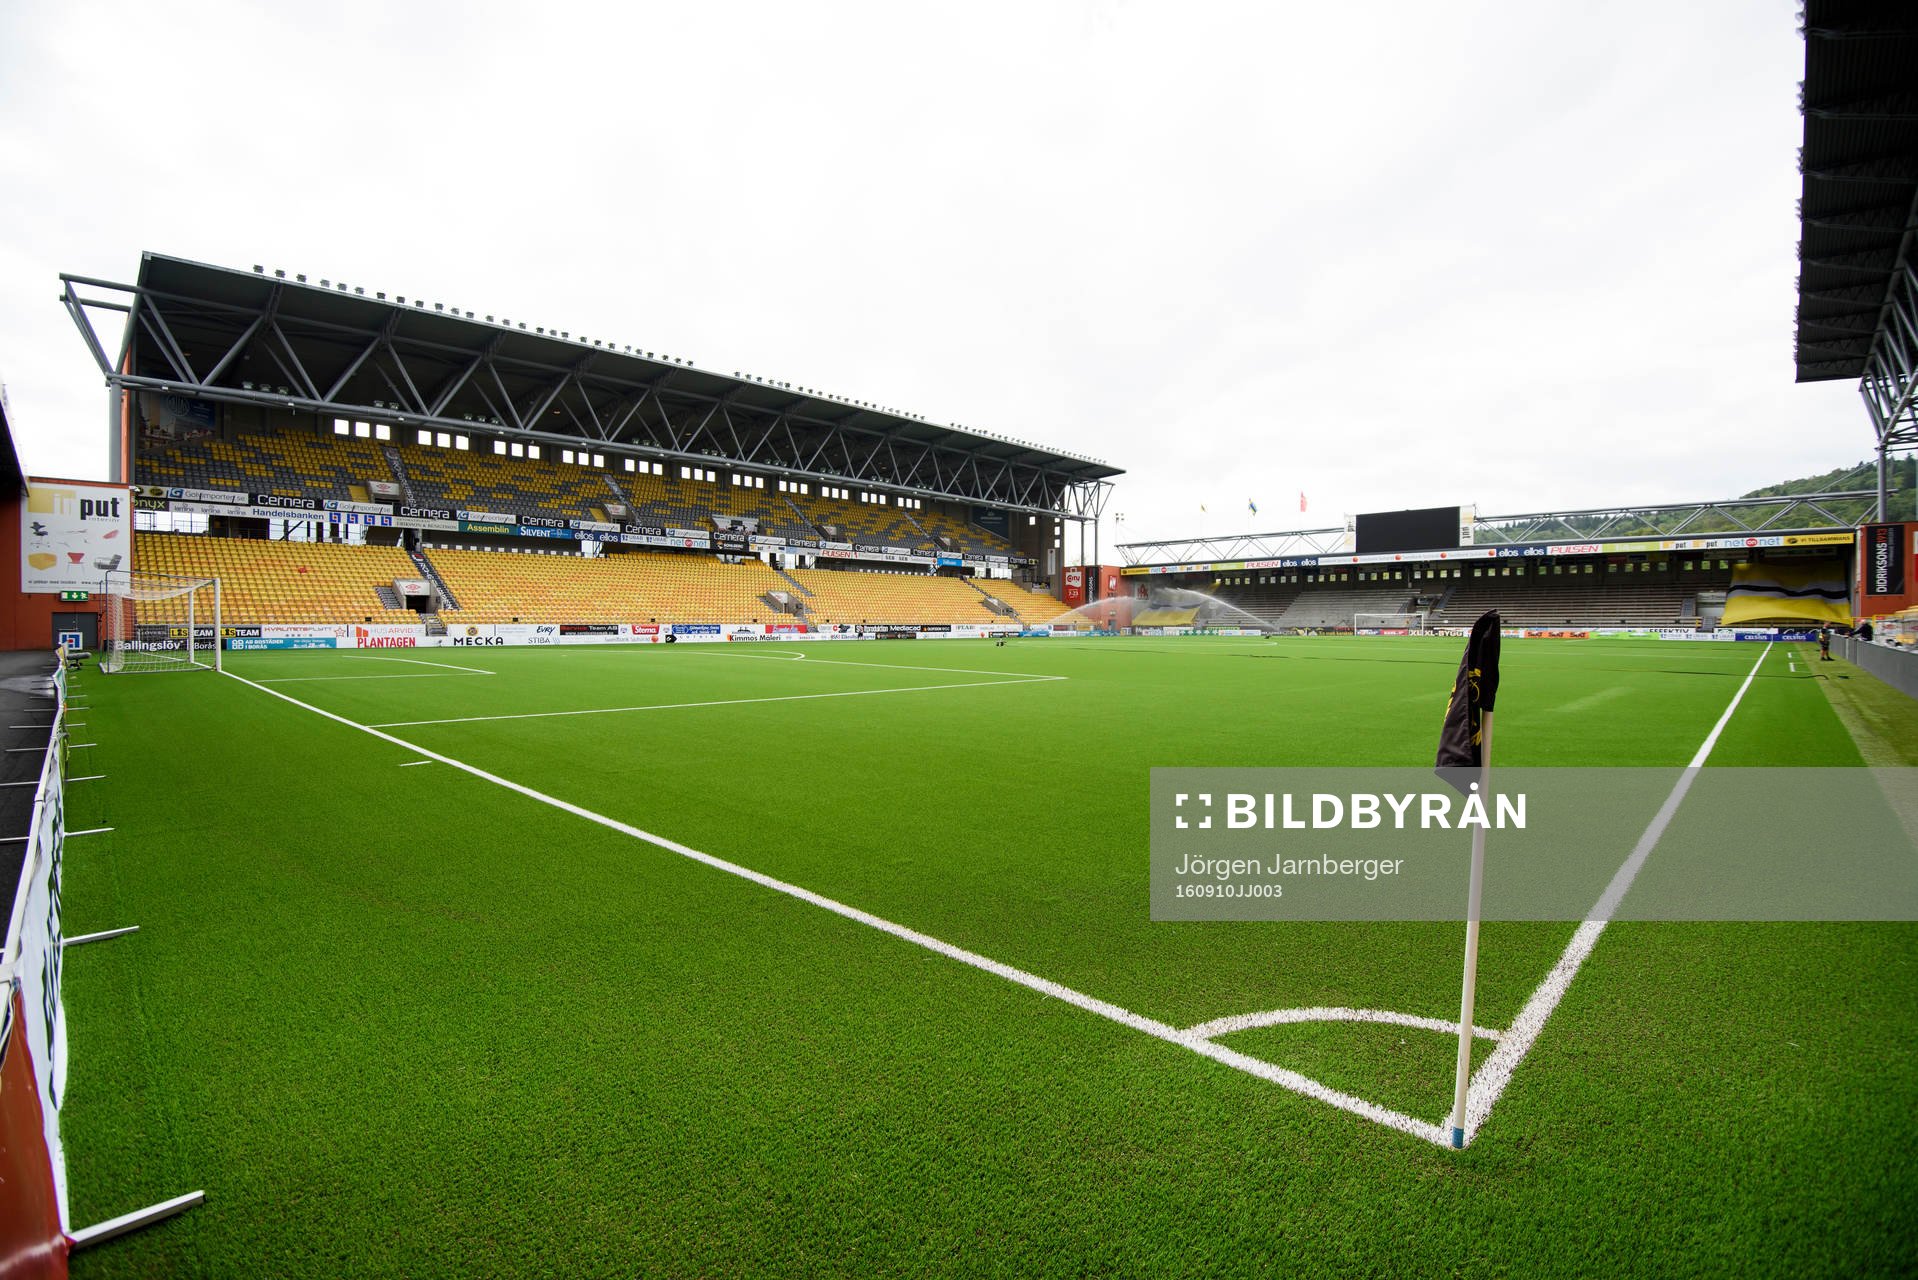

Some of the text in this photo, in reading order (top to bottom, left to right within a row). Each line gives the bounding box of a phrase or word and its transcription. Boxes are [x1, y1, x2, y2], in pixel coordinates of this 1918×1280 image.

[258, 495, 315, 508] Cernera
[253, 508, 324, 520] Handelsbanken
[401, 507, 450, 519] Cernera
[522, 516, 564, 527] Cernera
[467, 523, 509, 533] Assemblin
[625, 525, 662, 535] Cernera
[714, 532, 745, 542] Cernera
[789, 539, 816, 547] Cernera
[1550, 545, 1599, 554] PULSEN
[1876, 543, 1888, 592] DIDRIKSONS
[115, 640, 181, 651] Ballingslöv
[357, 637, 416, 648] PLANTAGEN
[454, 637, 504, 646] MECKA
